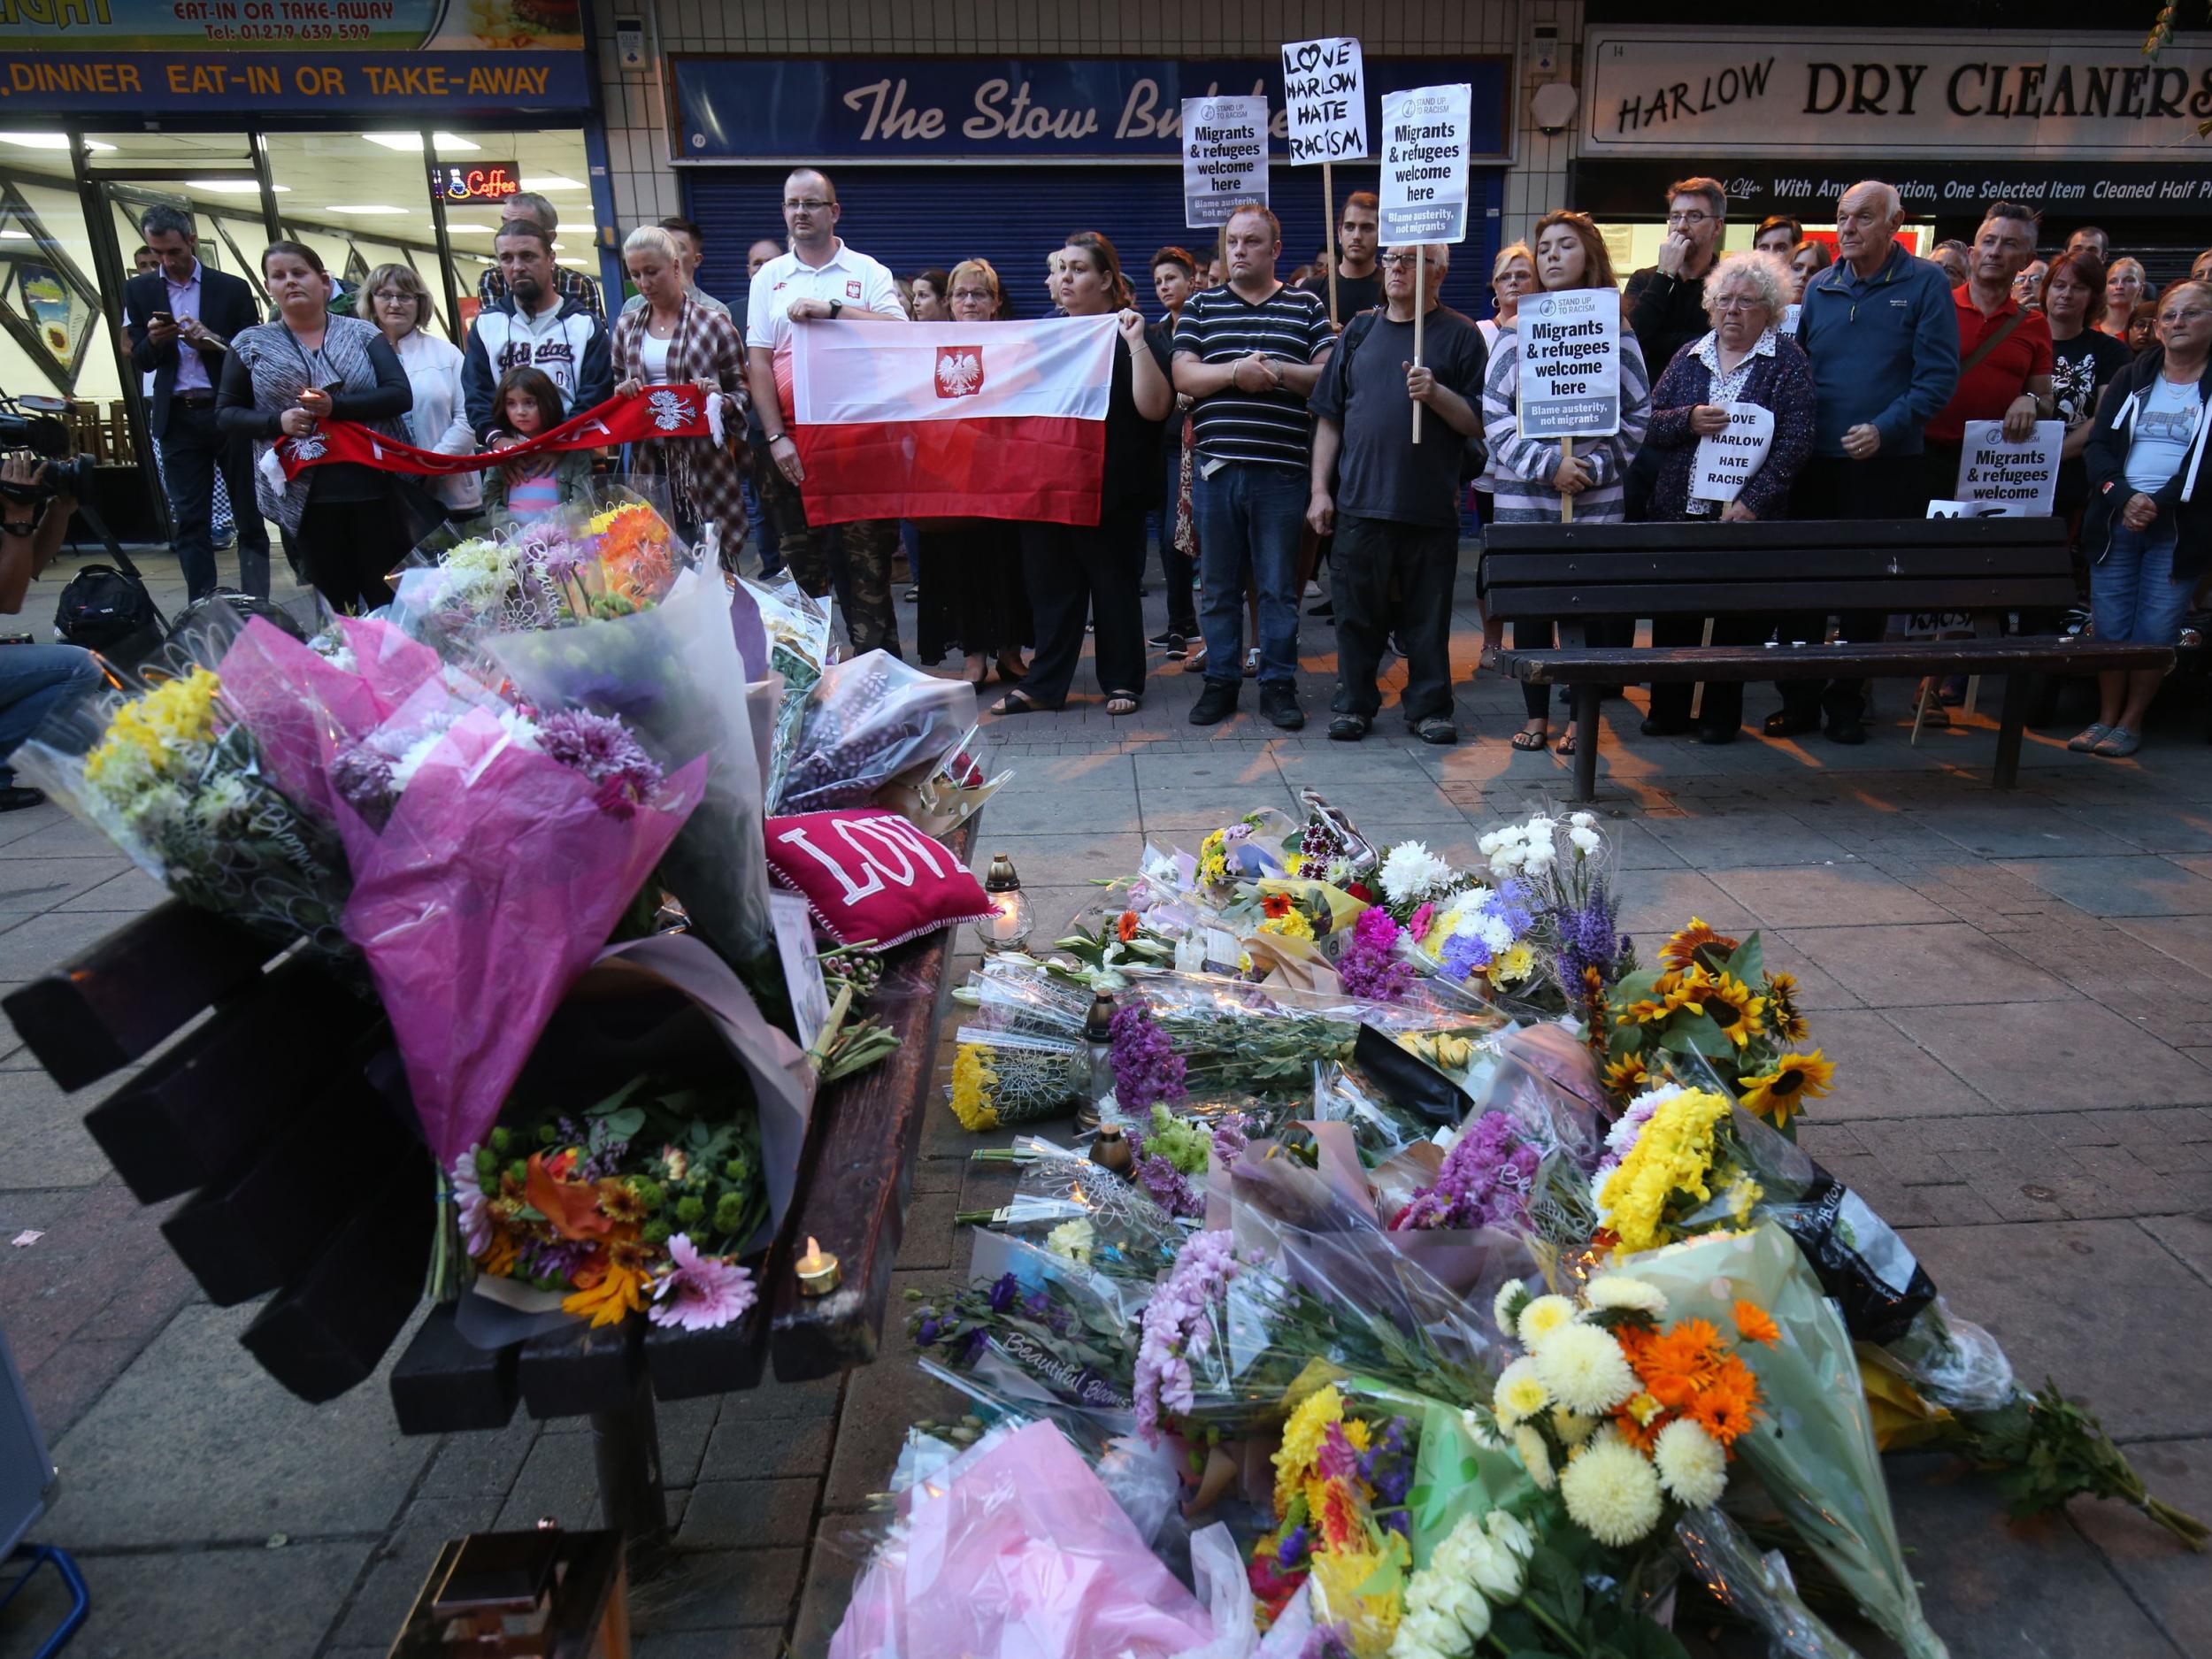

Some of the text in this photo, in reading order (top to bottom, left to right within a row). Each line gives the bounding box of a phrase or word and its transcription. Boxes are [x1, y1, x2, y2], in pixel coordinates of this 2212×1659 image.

[173, 3, 394, 19] EAT-IN OR TAKE-AWAY
[204, 24, 371, 40] Tel: 01279 639 599
[1613, 46, 1624, 57] 14
[166, 65, 282, 94] EAT-IN
[295, 66, 345, 95] OR
[363, 66, 549, 96] TAKE-AWAY
[1286, 69, 1356, 100] HARLOW
[1417, 97, 1436, 106] STAND
[1618, 57, 1775, 133] HARLOW
[1801, 63, 1928, 115] DRY
[843, 79, 946, 141] The
[963, 79, 1099, 139] Stow
[1297, 101, 1348, 126] HATE
[1424, 105, 1449, 114] RACISM
[1194, 125, 1255, 143] Migrants
[1394, 122, 1455, 144] Migrants
[1190, 143, 1260, 160] & refugees
[1389, 143, 1459, 163] & refugees
[1197, 161, 1254, 175] welcome
[1395, 165, 1451, 182] welcome
[468, 170, 516, 197] Coffee
[1211, 178, 1240, 191] here
[1732, 178, 1763, 196] Offer
[1773, 179, 1812, 196] With
[1816, 179, 1849, 203] Any
[1944, 180, 1975, 199] One
[1979, 180, 2047, 199] Selected
[2049, 180, 2086, 199] Item
[2093, 180, 2157, 199] Cleaned
[2159, 180, 2196, 199] Half
[1407, 186, 1434, 202] here
[1194, 199, 1219, 208] Blame
[1202, 208, 1215, 217] not
[1388, 209, 1454, 222] Blame austerity,
[1395, 221, 1446, 234] not migrants
[1558, 298, 1580, 307] STAND
[1569, 304, 1595, 313] RACISM
[1532, 320, 1603, 342] Migrants
[1527, 342, 1610, 359] & refugees
[1535, 361, 1602, 378] welcome
[1551, 380, 1586, 396] here
[1532, 402, 1607, 415] Blame austerity,
[1540, 414, 1600, 426] not migrants
[1711, 434, 1763, 447] HARLOW
[1719, 457, 1749, 467] HATE
[1975, 450, 2046, 468] Migrants
[1967, 468, 2048, 485] & refugees
[1973, 486, 2039, 499] welcome
[1003, 1332, 1087, 1393] Beautiful
